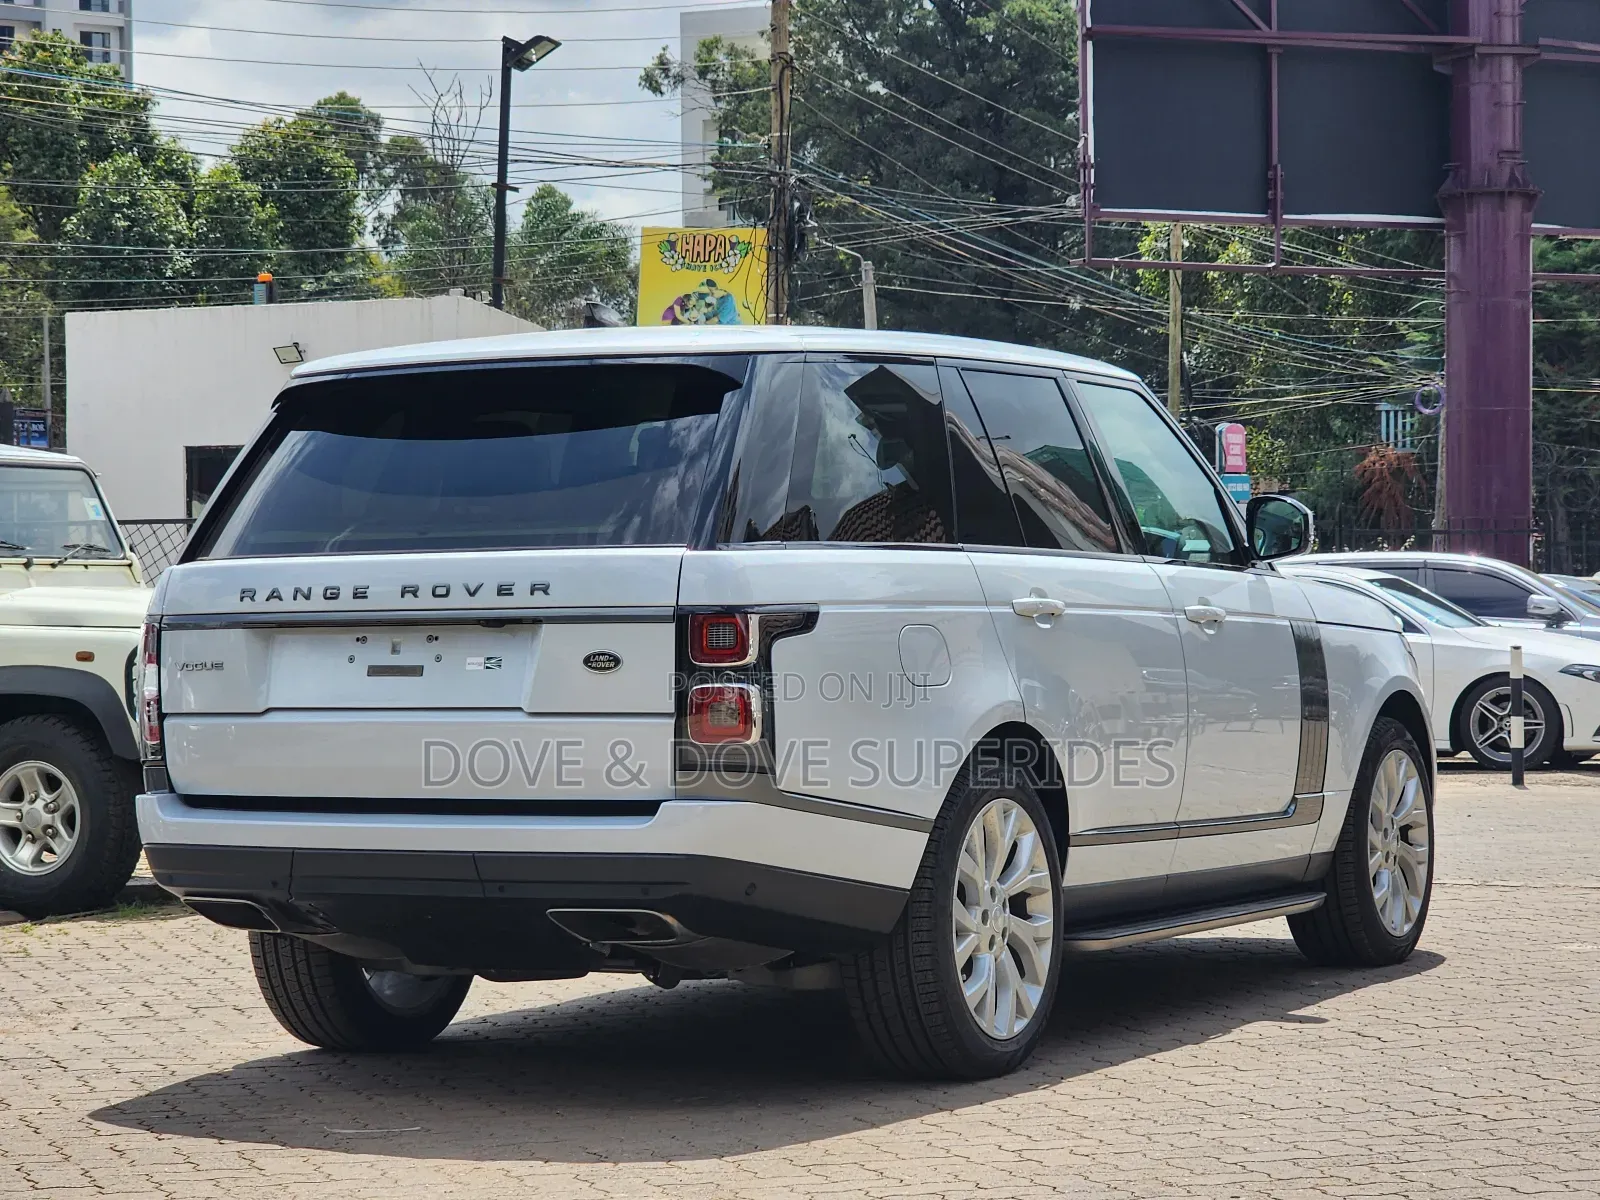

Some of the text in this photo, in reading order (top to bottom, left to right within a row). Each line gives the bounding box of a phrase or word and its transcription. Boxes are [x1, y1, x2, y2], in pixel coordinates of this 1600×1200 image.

[681, 233, 726, 263] HAPA
[239, 581, 550, 602] RANGE ROVER
[174, 661, 224, 671] VOGUE
